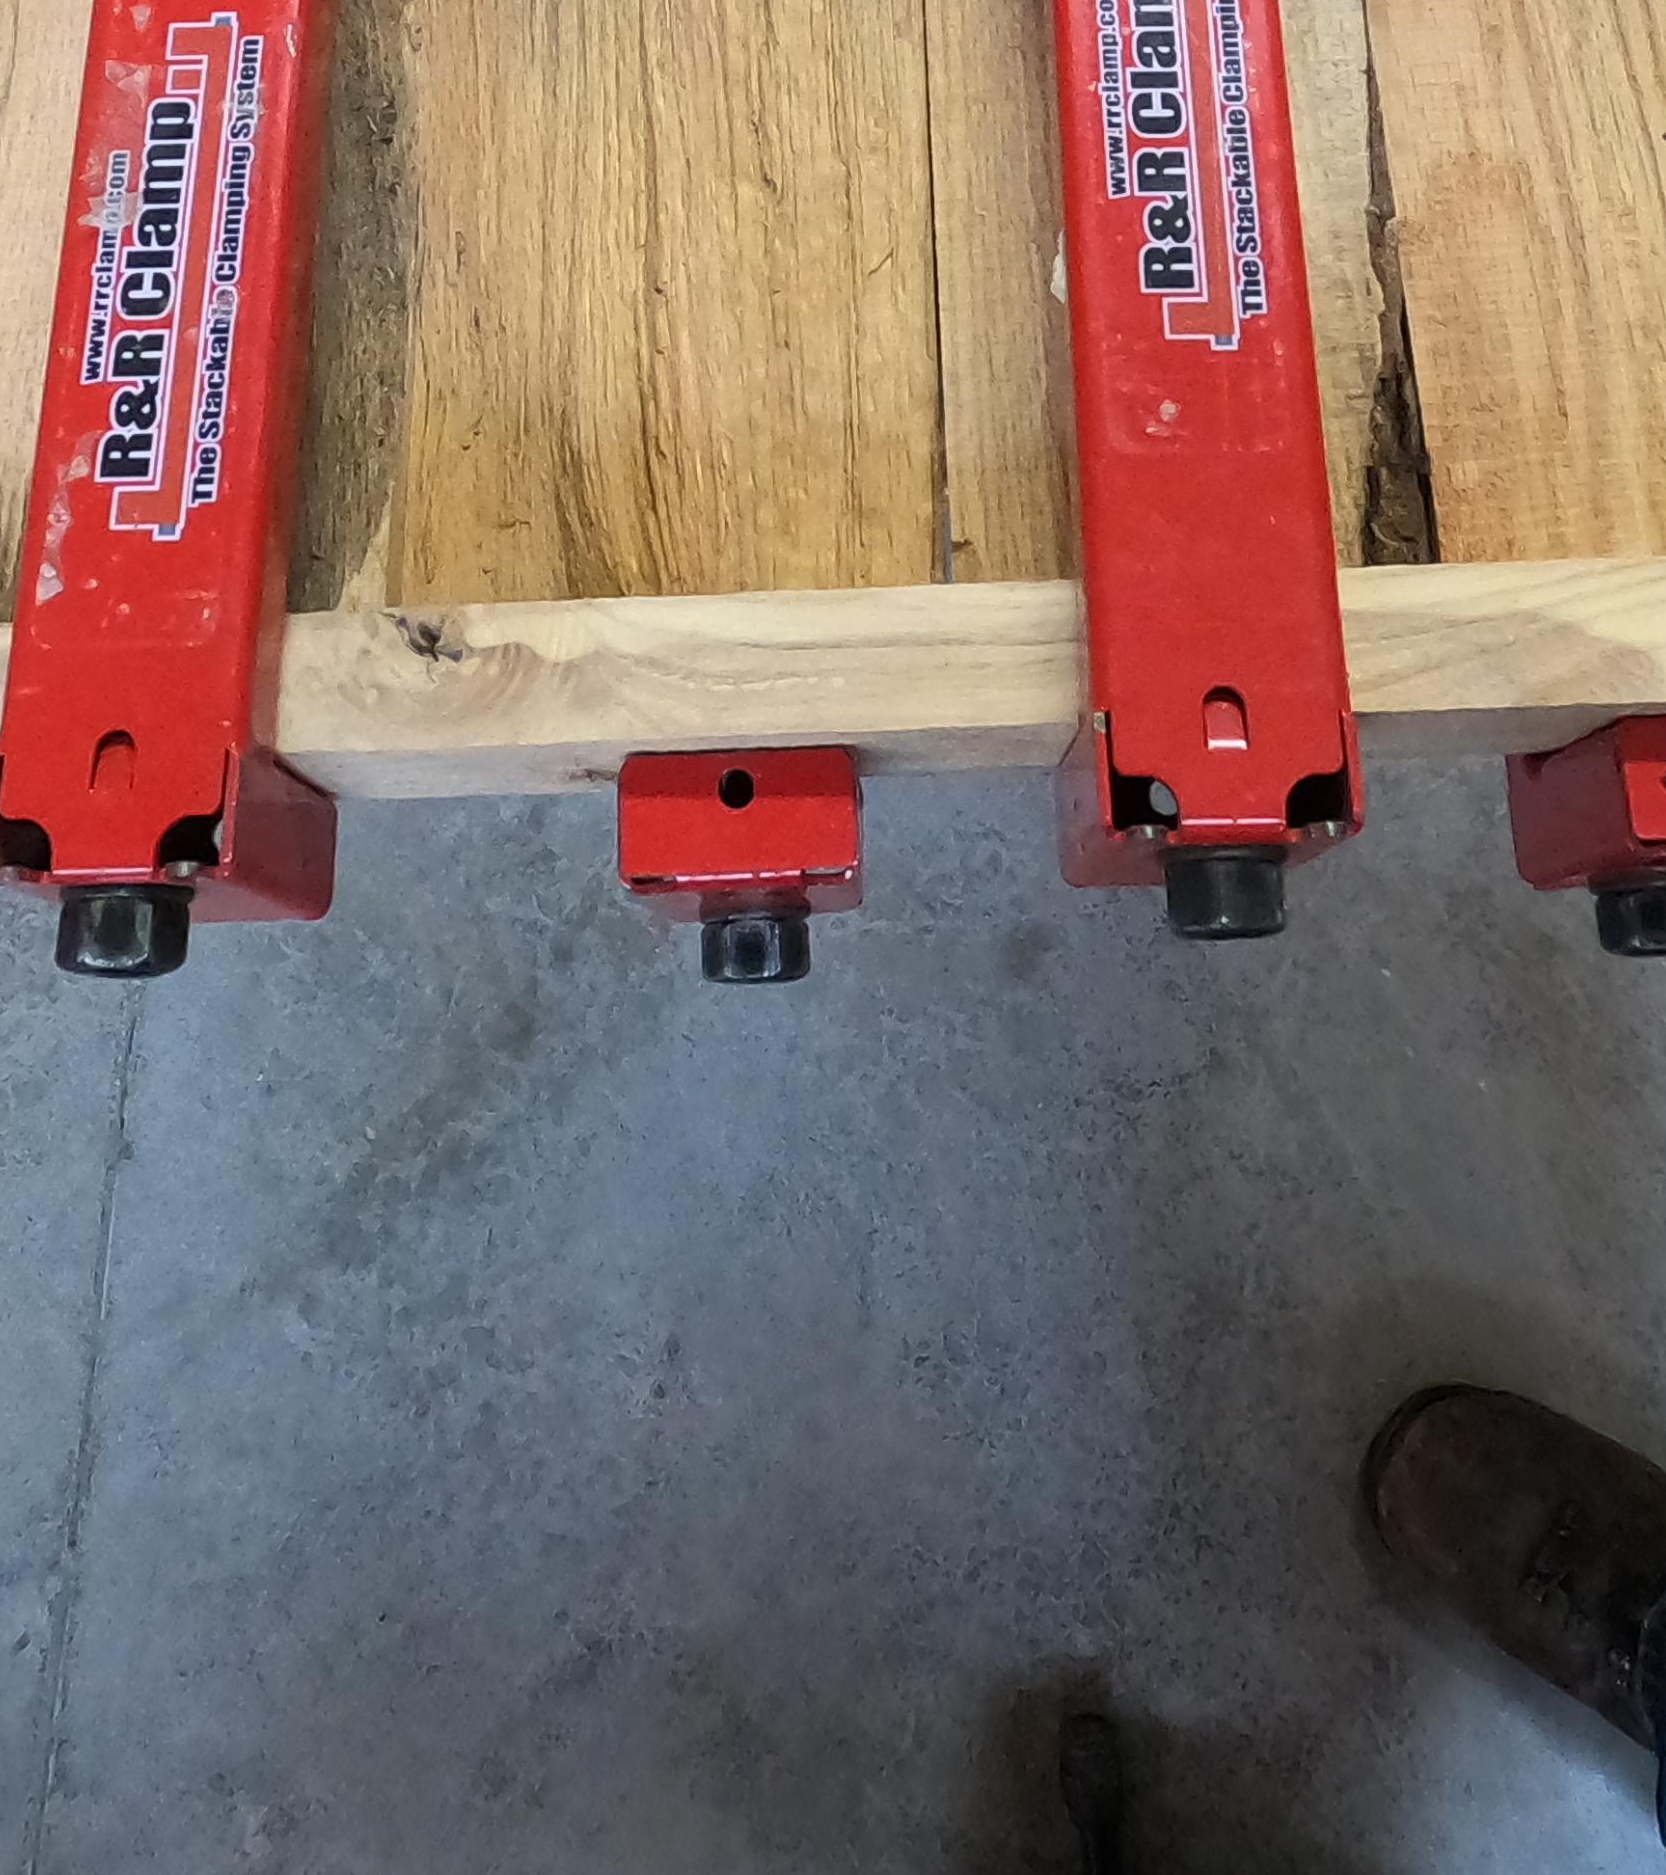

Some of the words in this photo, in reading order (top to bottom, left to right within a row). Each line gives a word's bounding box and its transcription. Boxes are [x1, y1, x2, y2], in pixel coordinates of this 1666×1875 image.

[229, 38, 260, 141] System
[120, 100, 195, 317] Clamp
[215, 145, 252, 283] Clamping
[1136, 150, 1196, 290] R&R
[1225, 107, 1259, 255] Stackable
[1240, 258, 1264, 314] The
[99, 333, 169, 478] R&R
[198, 287, 236, 440] Stackable
[191, 446, 218, 505] The
